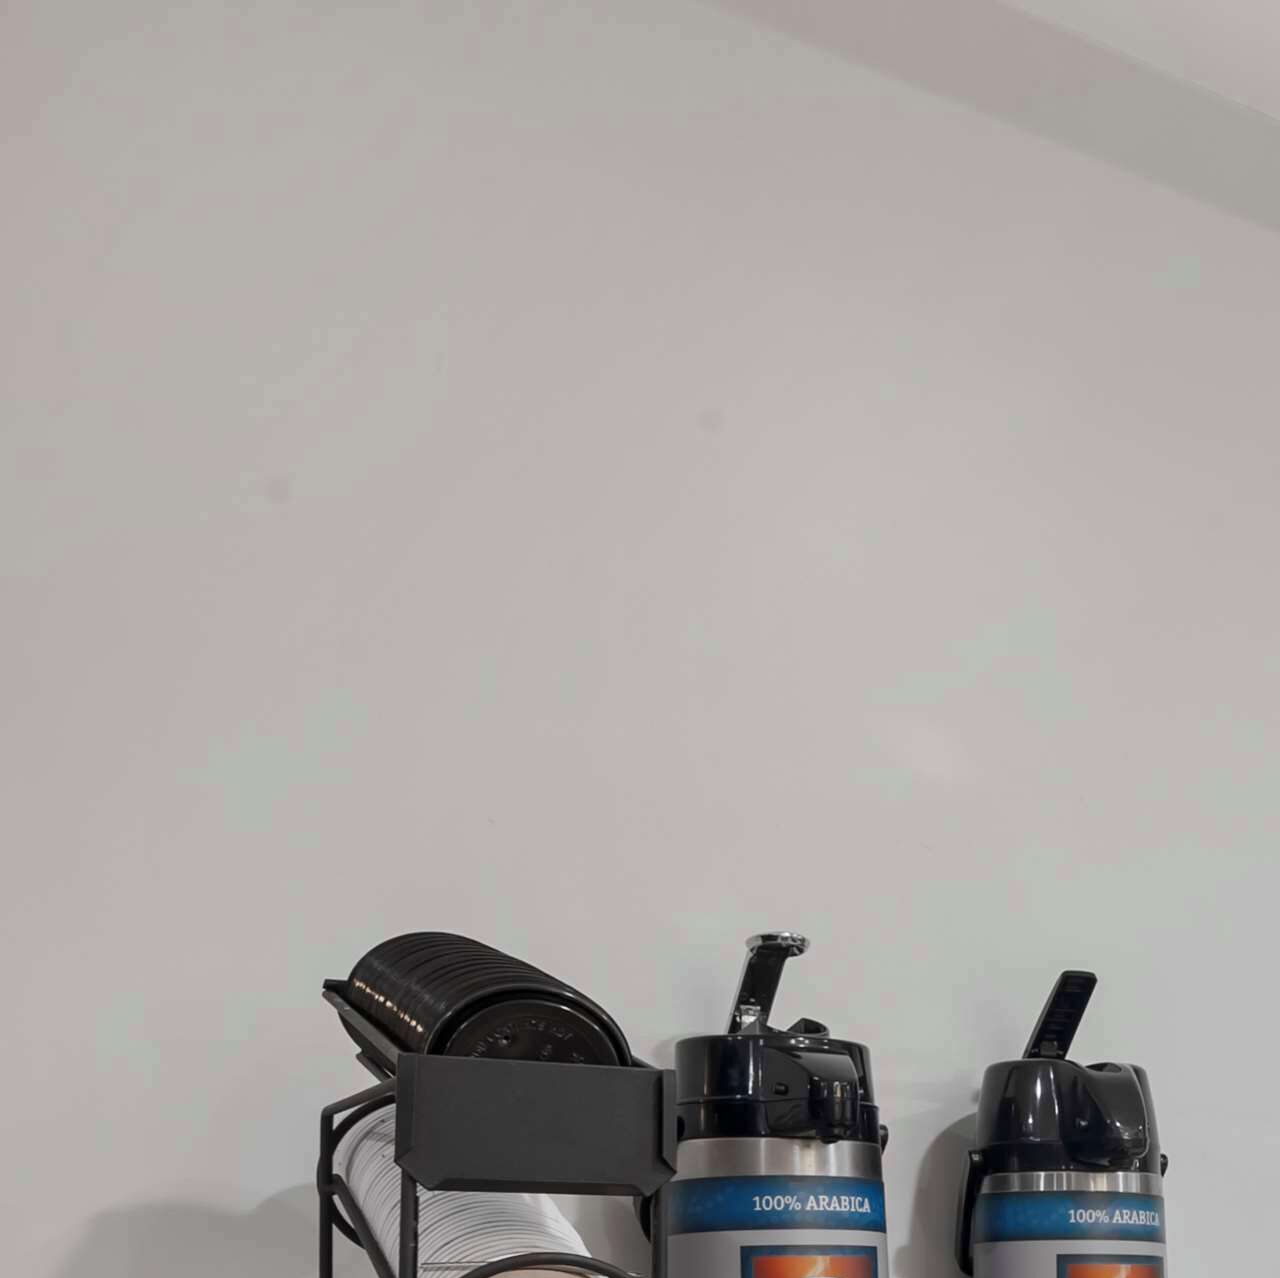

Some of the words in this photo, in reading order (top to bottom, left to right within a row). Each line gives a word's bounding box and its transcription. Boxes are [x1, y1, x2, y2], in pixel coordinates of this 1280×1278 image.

[753, 1195, 801, 1211] 100%
[806, 1195, 871, 1213] ARABICA
[1068, 1209, 1110, 1223] 100%
[1112, 1209, 1160, 1227] ARABICA
